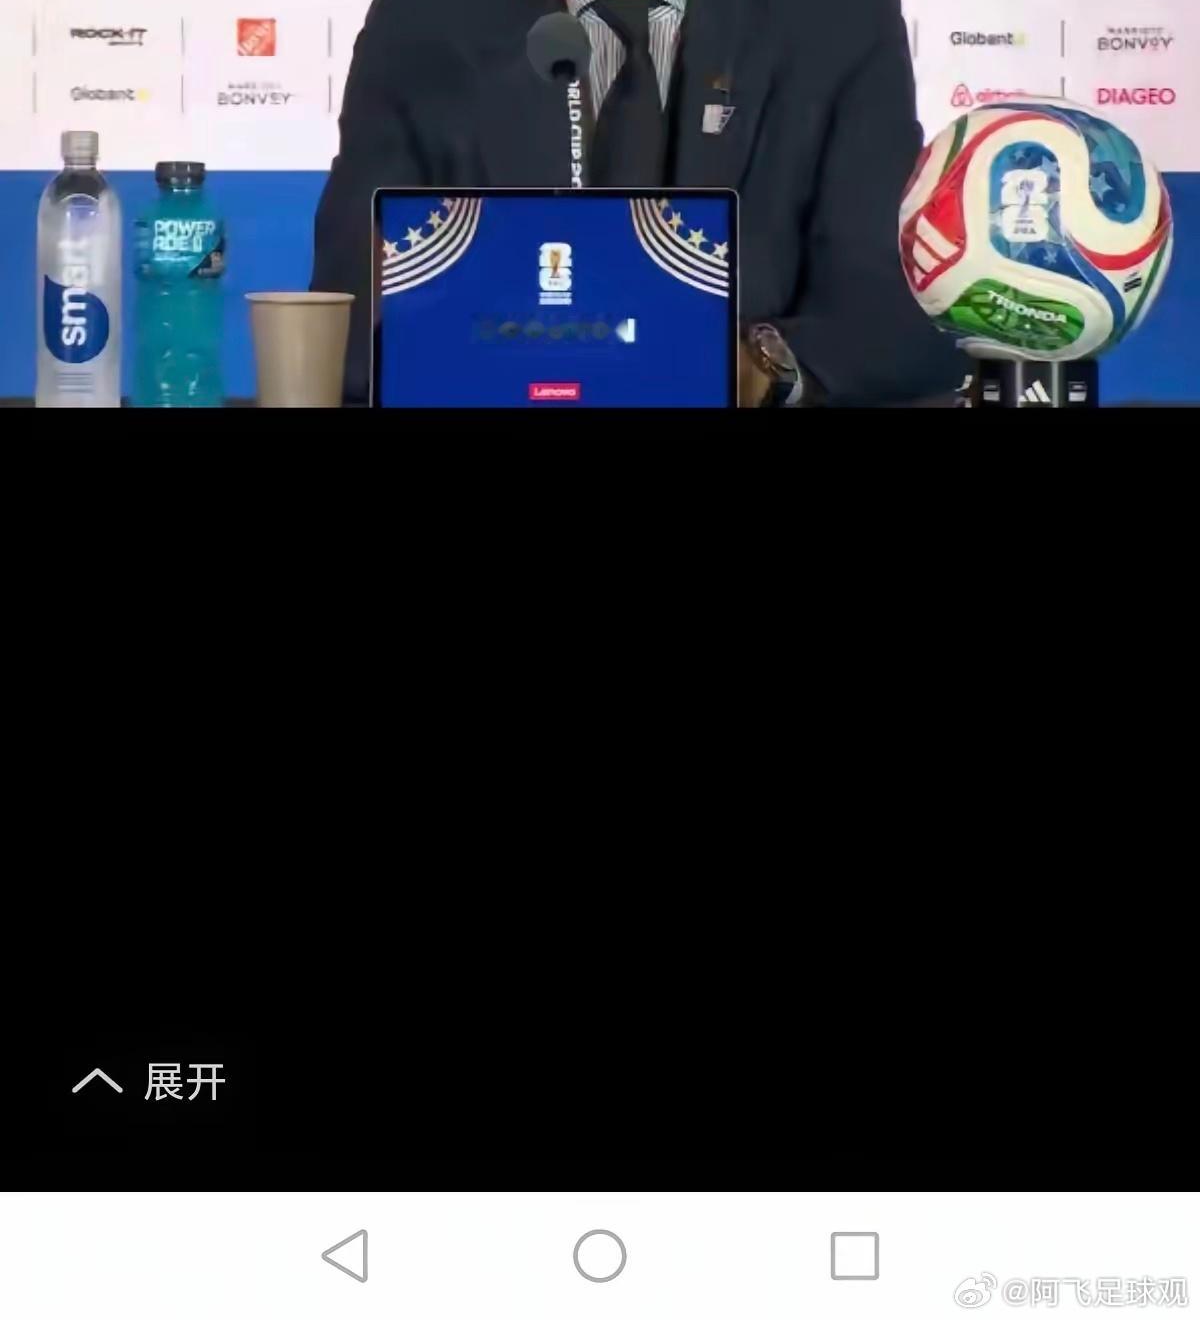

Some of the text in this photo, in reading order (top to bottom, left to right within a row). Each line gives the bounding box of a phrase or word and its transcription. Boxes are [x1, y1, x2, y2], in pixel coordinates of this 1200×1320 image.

[950, 32, 1014, 46] Globant
[1097, 88, 1176, 105] DIAGEO
[154, 219, 216, 238] POWER
[58, 240, 88, 346] smart
